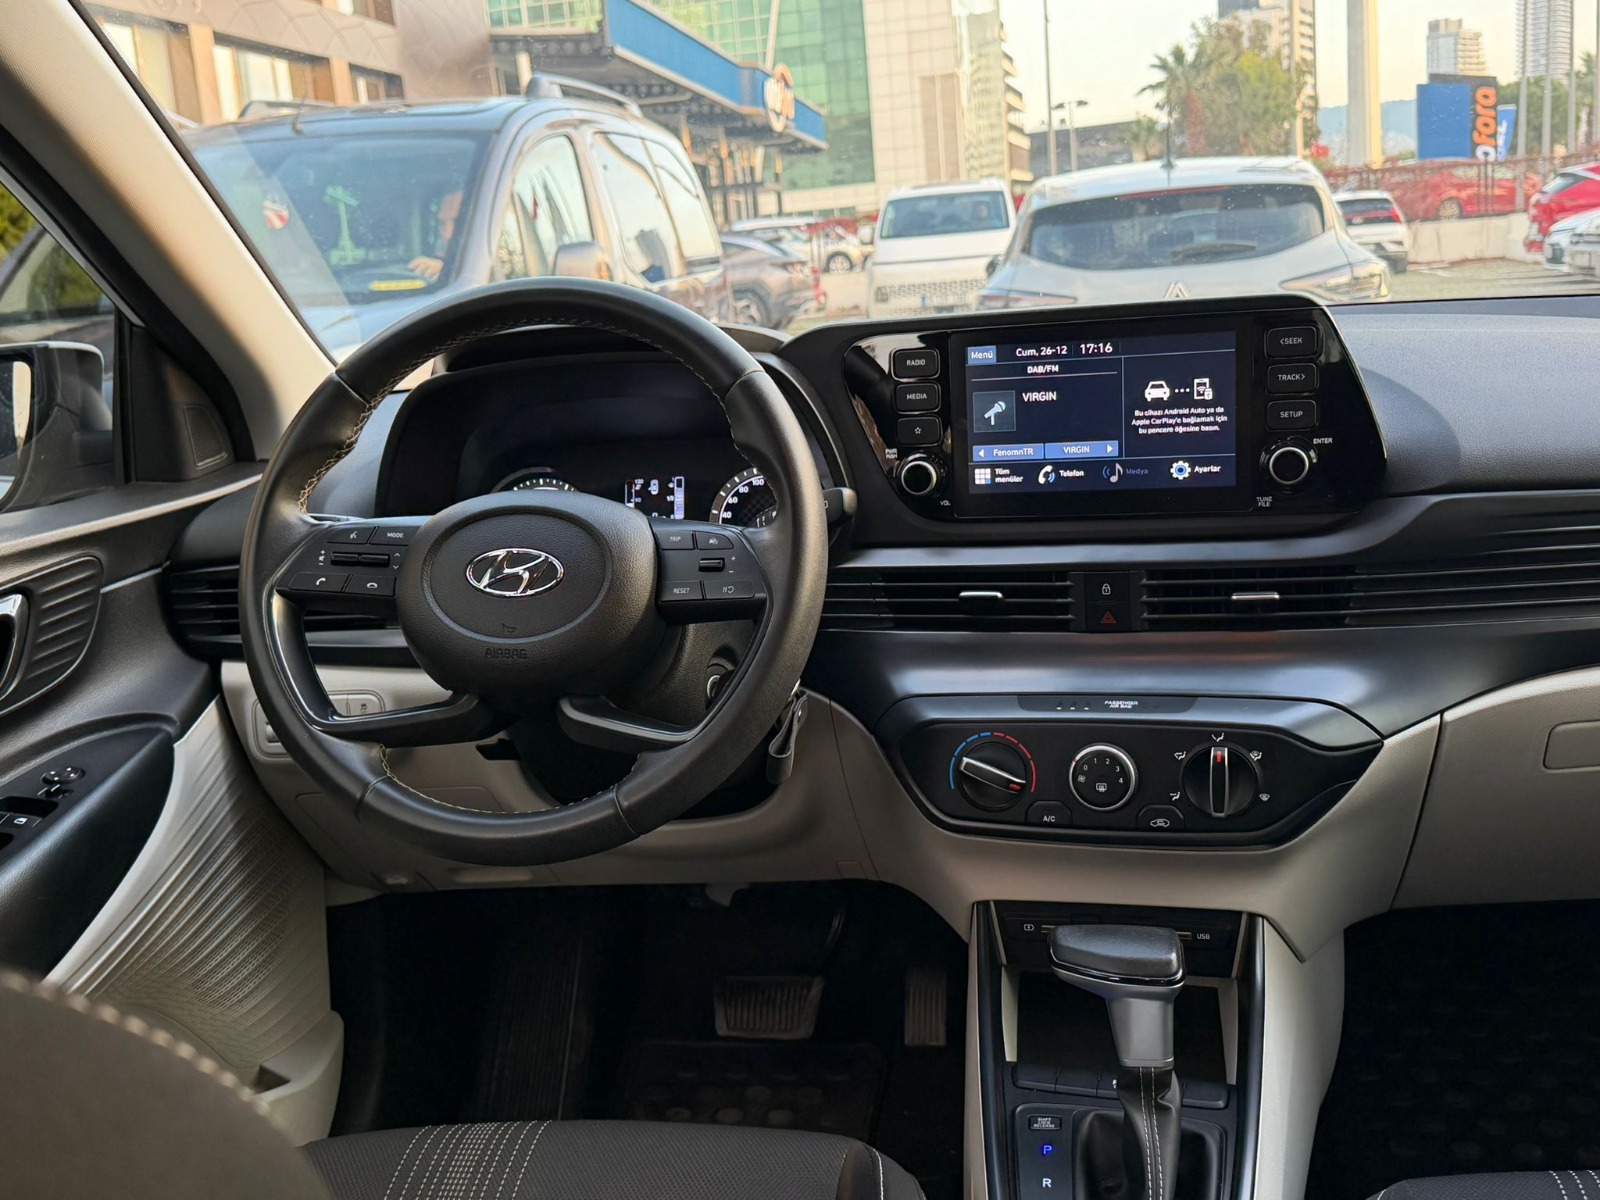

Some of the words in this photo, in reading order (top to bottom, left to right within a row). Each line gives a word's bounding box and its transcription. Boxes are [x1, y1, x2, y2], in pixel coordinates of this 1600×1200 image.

[1016, 348, 1039, 357] Cum,
[1040, 345, 1068, 355] 26-12
[1080, 342, 1113, 354] 17:16
[971, 351, 993, 359] Menü
[1027, 365, 1059, 373] DAB/FM
[1022, 391, 1057, 402] VIRGIN
[1164, 407, 1190, 415] Android
[1206, 407, 1215, 416] ya
[1280, 410, 1303, 418] SETUP
[1131, 418, 1150, 426] Apple
[1182, 416, 1215, 424] bağlamak
[993, 448, 1034, 457] FenomnTR
[1063, 446, 1090, 454] VIRGIN
[995, 467, 1010, 475] Tüm
[1059, 469, 1084, 477] Telefon
[1194, 465, 1221, 474] Ayarlar
[995, 475, 1023, 483] menüler
[484, 648, 528, 659] AIRBAG
[1043, 1145, 1052, 1155] P
[1042, 1178, 1052, 1188] R
